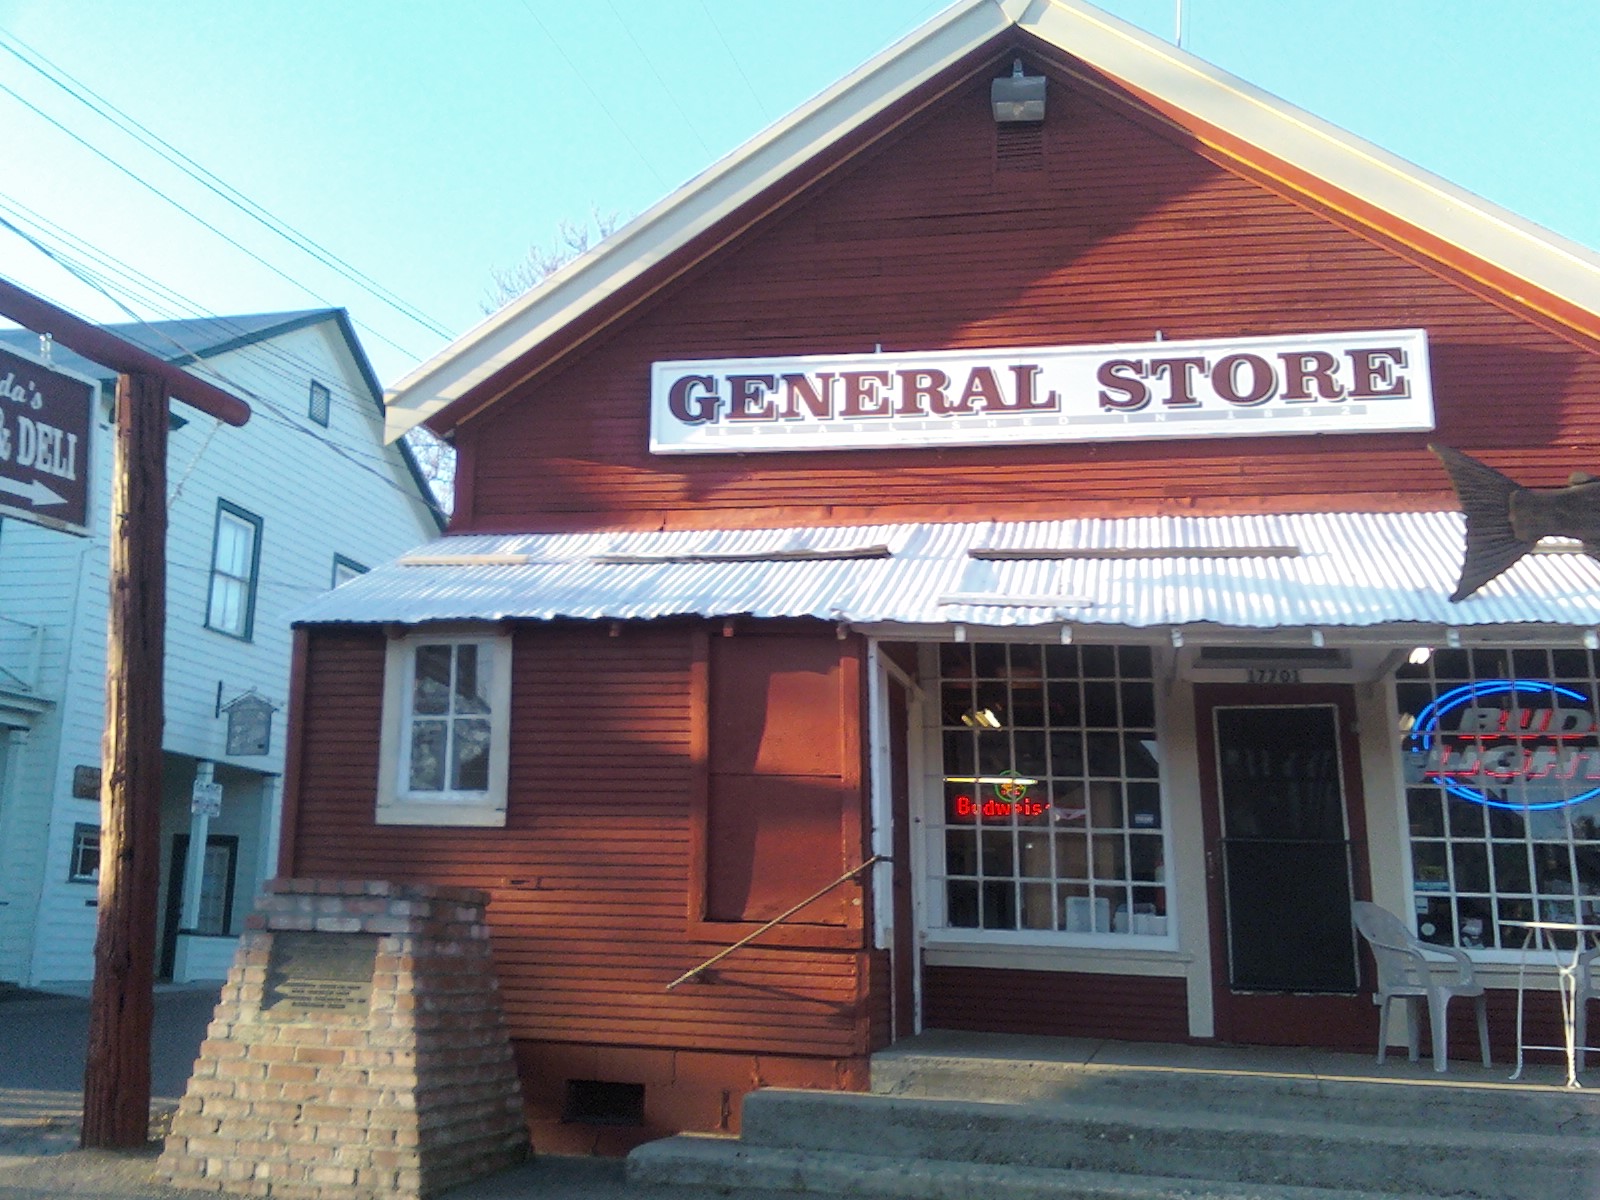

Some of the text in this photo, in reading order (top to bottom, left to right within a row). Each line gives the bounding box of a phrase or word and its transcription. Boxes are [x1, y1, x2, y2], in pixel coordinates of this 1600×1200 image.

[668, 346, 1411, 425] GENERAL STORE
[717, 405, 1353, 437] ESTABLISHED IN 1852
[16, 415, 78, 480] DELI
[1459, 707, 1598, 739] BUD
